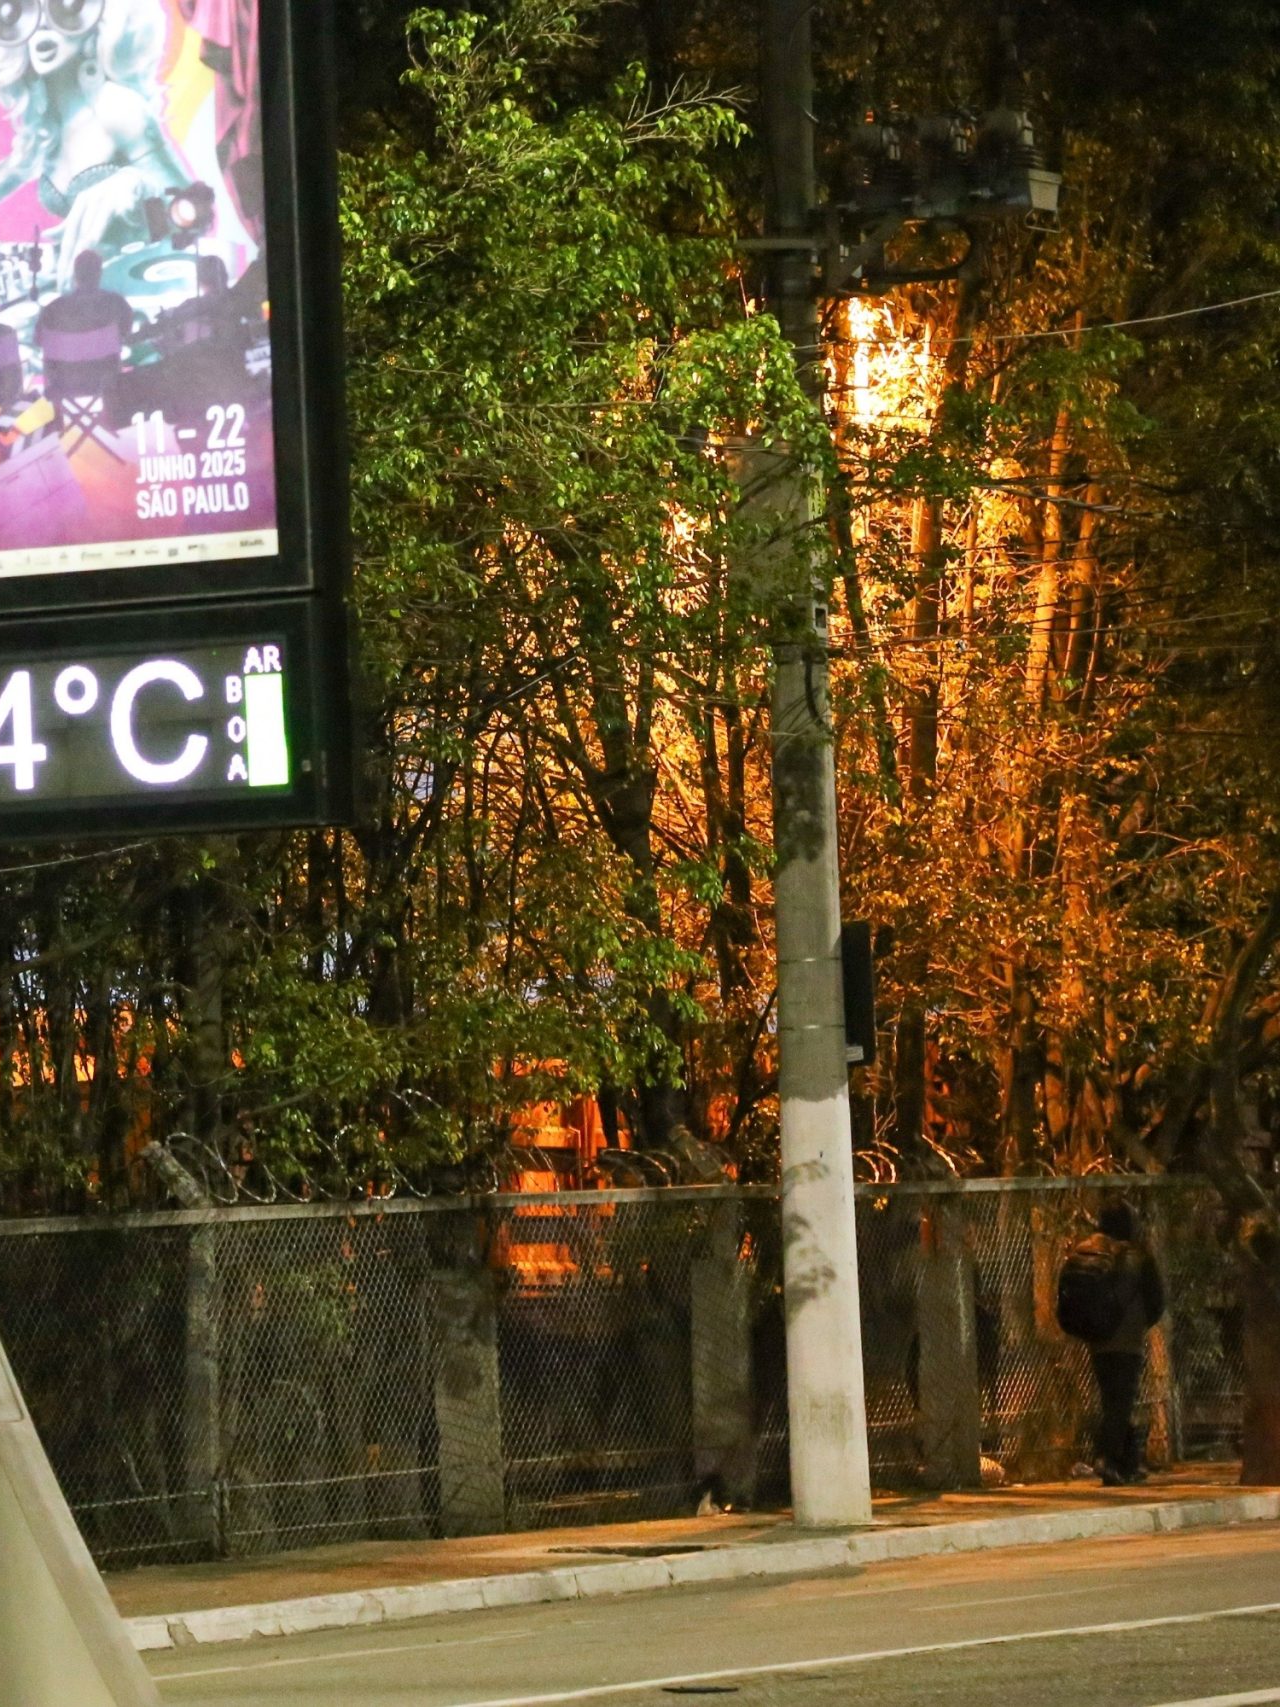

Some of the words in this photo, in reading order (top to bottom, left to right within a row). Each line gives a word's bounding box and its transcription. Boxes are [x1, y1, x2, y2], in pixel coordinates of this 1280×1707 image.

[131, 409, 166, 455] 11
[205, 403, 246, 449] 22
[135, 453, 197, 484] JUNHO
[200, 448, 246, 479] 2025
[136, 484, 178, 520] SÃO
[182, 481, 250, 516] PAULO
[243, 645, 282, 674] AR
